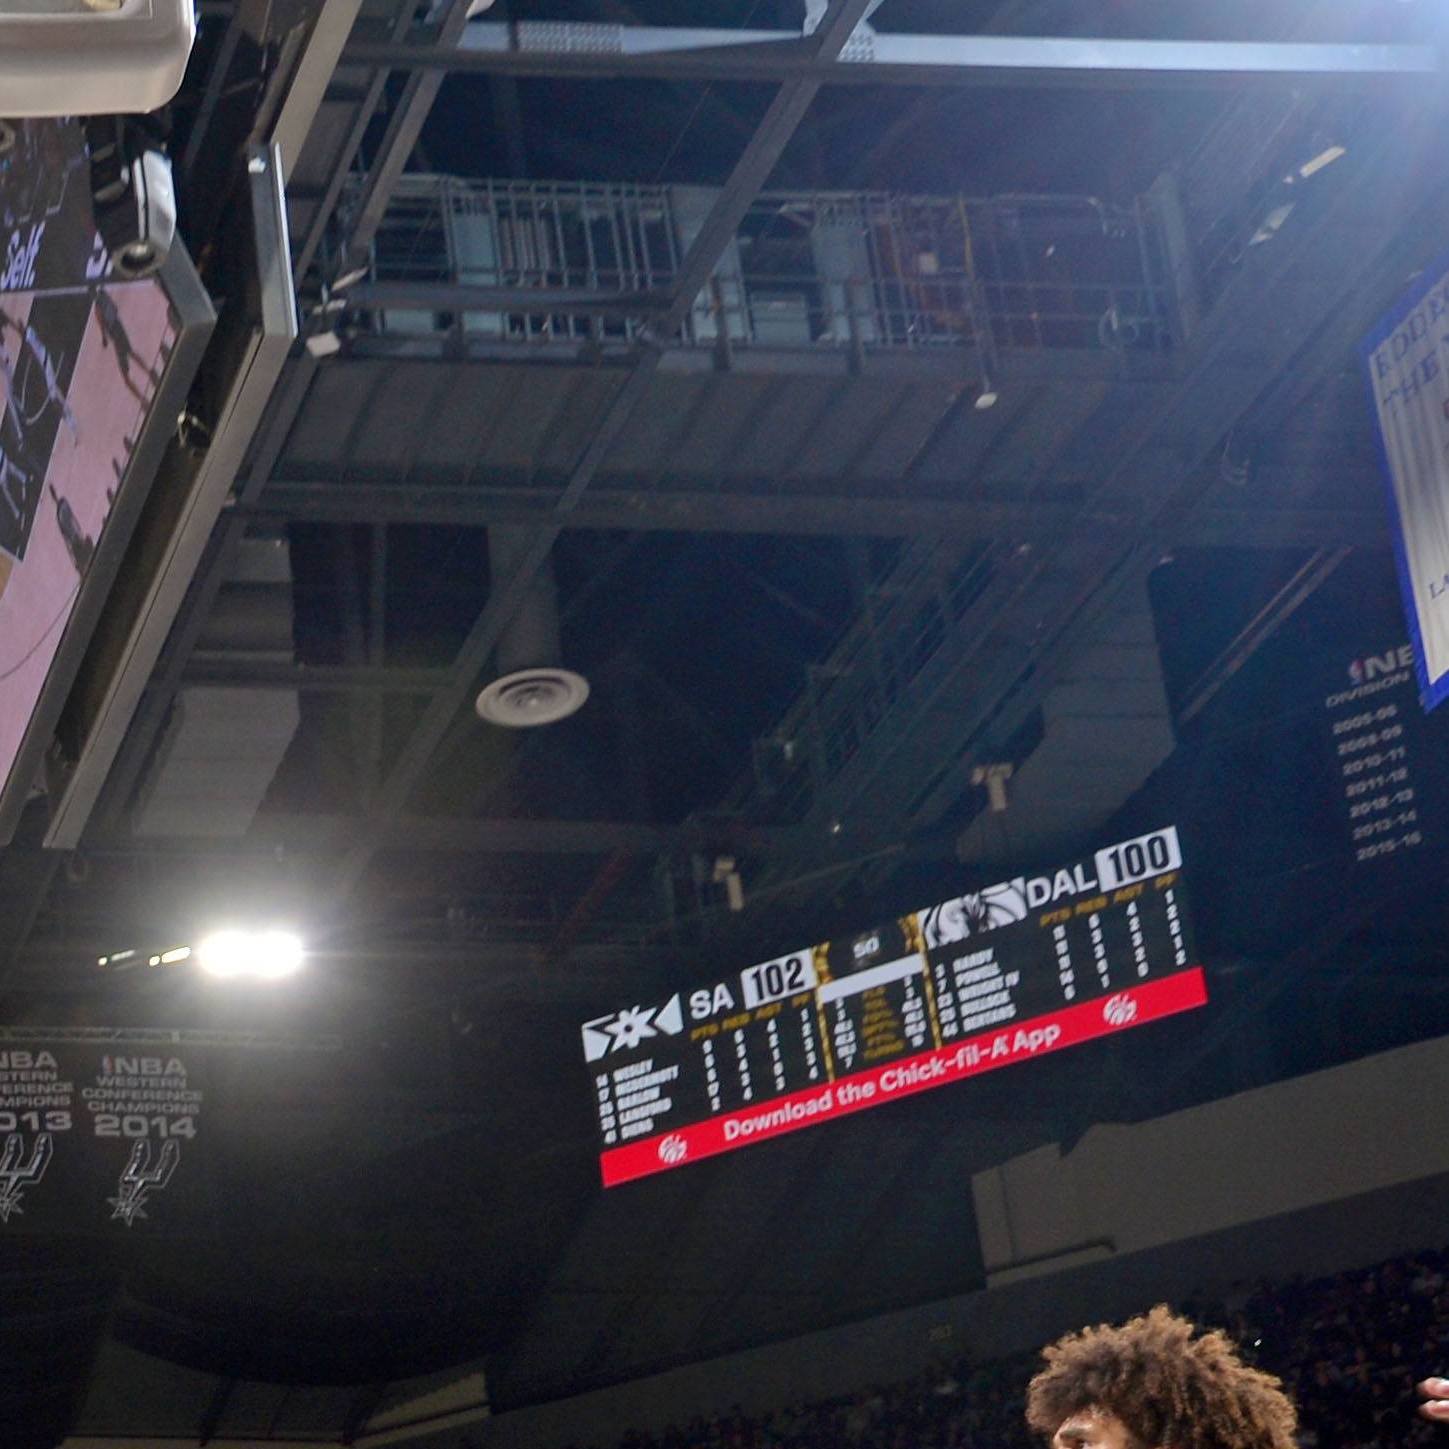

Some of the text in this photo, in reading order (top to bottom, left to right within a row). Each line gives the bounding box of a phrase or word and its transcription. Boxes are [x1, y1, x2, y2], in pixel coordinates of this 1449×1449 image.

[1025, 835, 1169, 909] DAL 100
[689, 957, 804, 1020] SA 102
[114, 1057, 187, 1076] NBA
[95, 1075, 187, 1089] WESTERN
[724, 1089, 834, 1142] Download
[837, 1077, 875, 1105] the
[1012, 1024, 1061, 1055] App
[82, 1087, 203, 1101] CONFERENCE
[87, 1100, 200, 1115] CHAMPIONS
[94, 1115, 196, 1138] 2014
